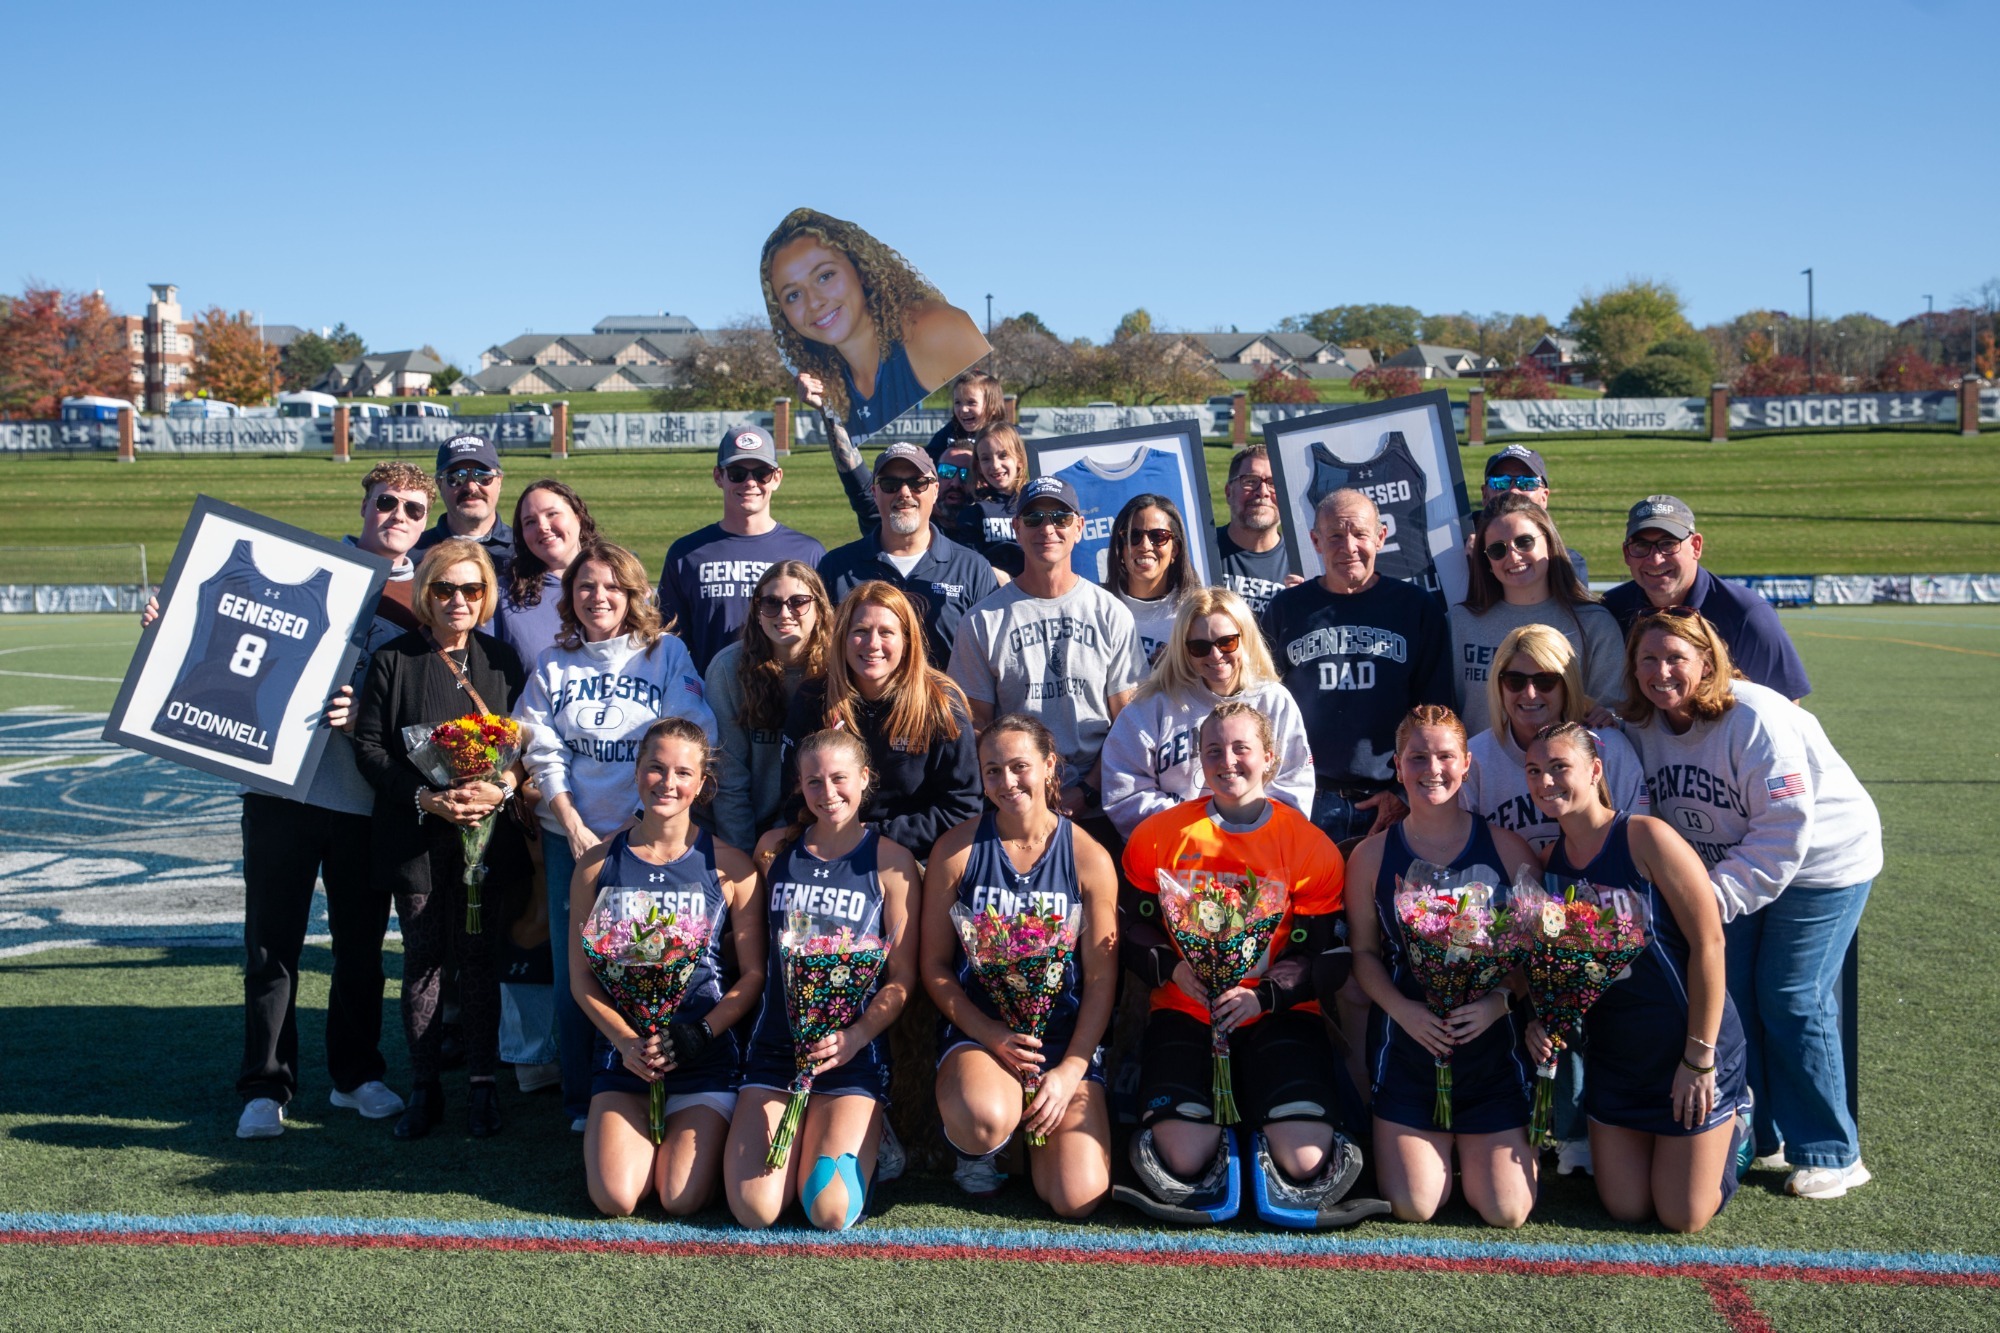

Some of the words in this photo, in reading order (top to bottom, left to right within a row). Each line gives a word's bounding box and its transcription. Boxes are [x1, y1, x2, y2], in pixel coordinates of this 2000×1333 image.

[660, 416, 686, 430] ONE
[1526, 413, 1596, 429] GENESEO
[1599, 412, 1666, 428] KNIGHTS
[1764, 398, 1881, 427] SOCCER
[0, 423, 53, 450] CER
[173, 430, 234, 446] GENESEO
[238, 429, 298, 445] KNIGHTS
[379, 423, 425, 443] FIELD
[428, 422, 498, 442] HOCKEY
[649, 430, 697, 443] KNIGHT
[700, 584, 735, 599] FIELD
[217, 592, 309, 640] GENESEO
[1009, 616, 1096, 654] GENESEO
[1286, 625, 1407, 667] GENESEO
[229, 633, 268, 678] 8
[1318, 661, 1376, 691] DAD
[550, 672, 662, 719] GENESEO
[1024, 681, 1056, 701] FIELD
[166, 700, 269, 751] O'DONNELL
[594, 710, 606, 727] 8
[1645, 764, 1749, 819] GENESEO
[1683, 810, 1703, 830] 13
[770, 882, 867, 922] GENESEO
[972, 885, 1068, 923] GENESEO
